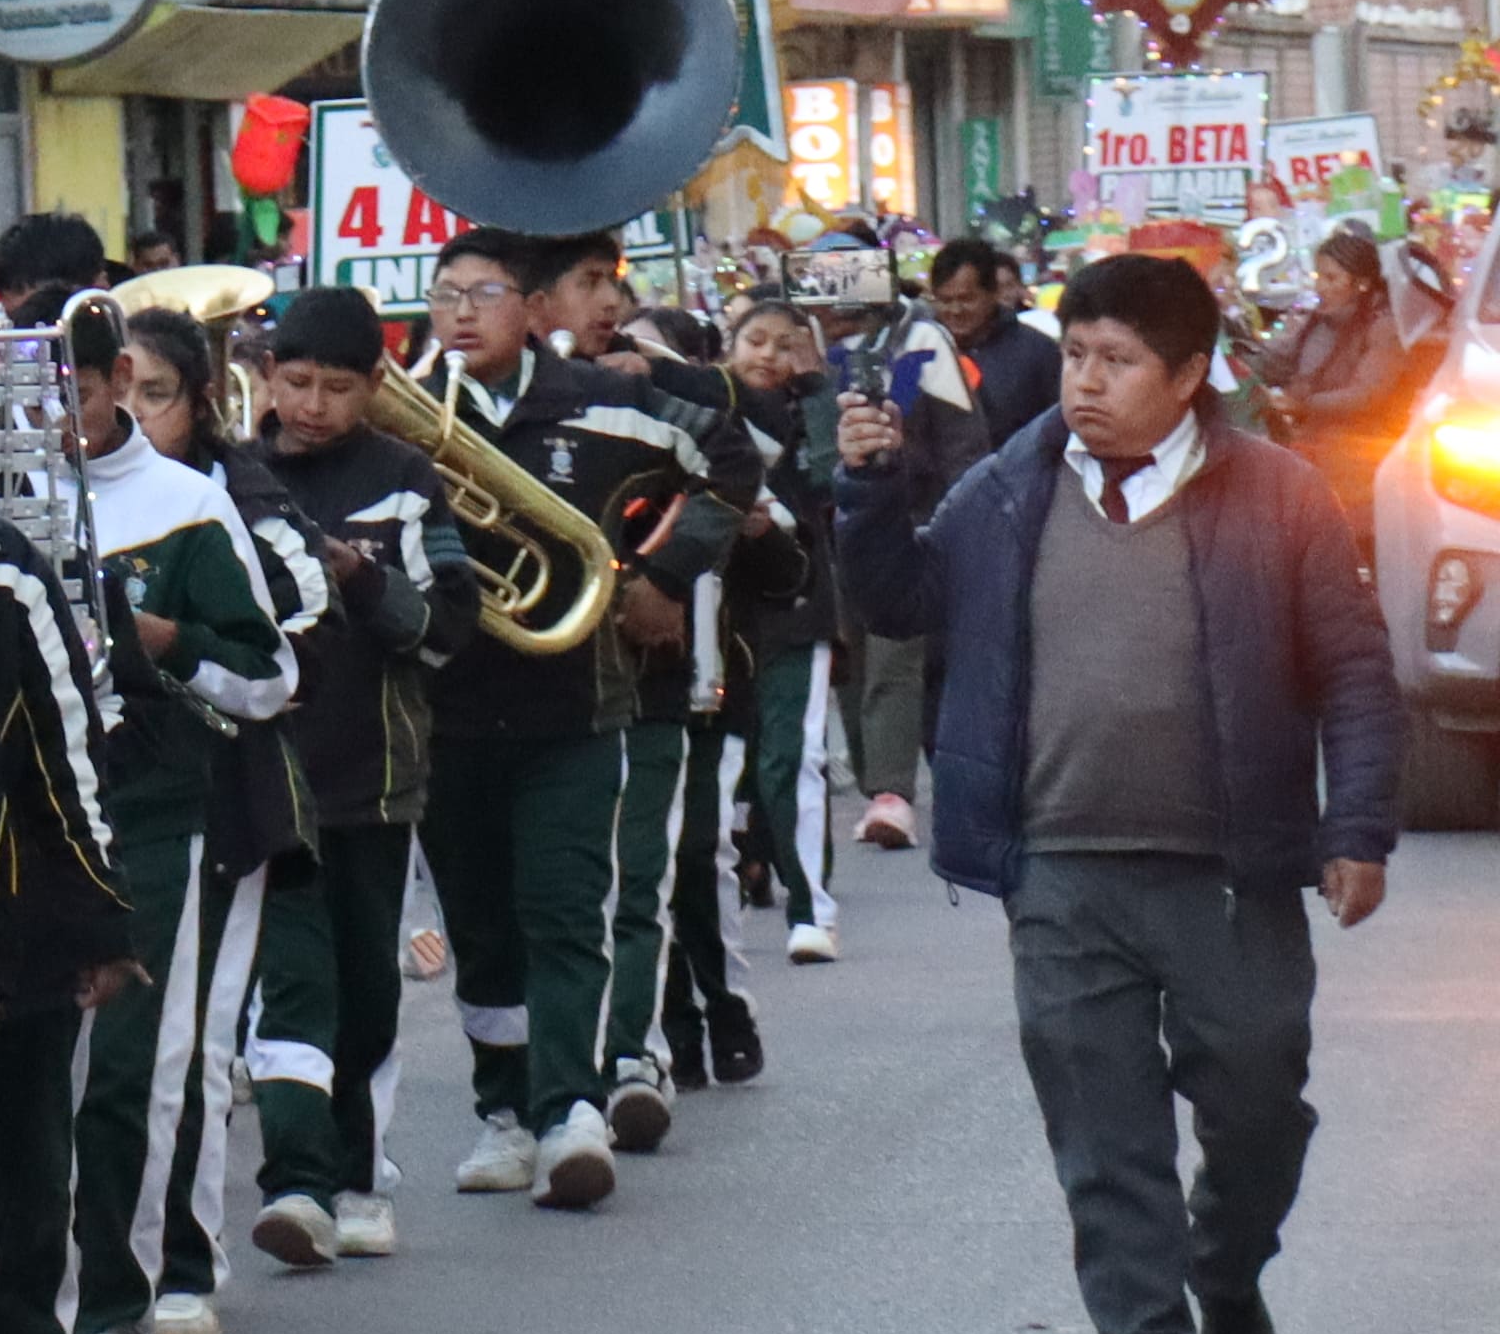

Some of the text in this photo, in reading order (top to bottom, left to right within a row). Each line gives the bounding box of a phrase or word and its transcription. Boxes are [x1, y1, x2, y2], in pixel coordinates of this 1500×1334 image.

[1097, 124, 1248, 167] 1ro. BETA
[338, 186, 384, 247] 4
